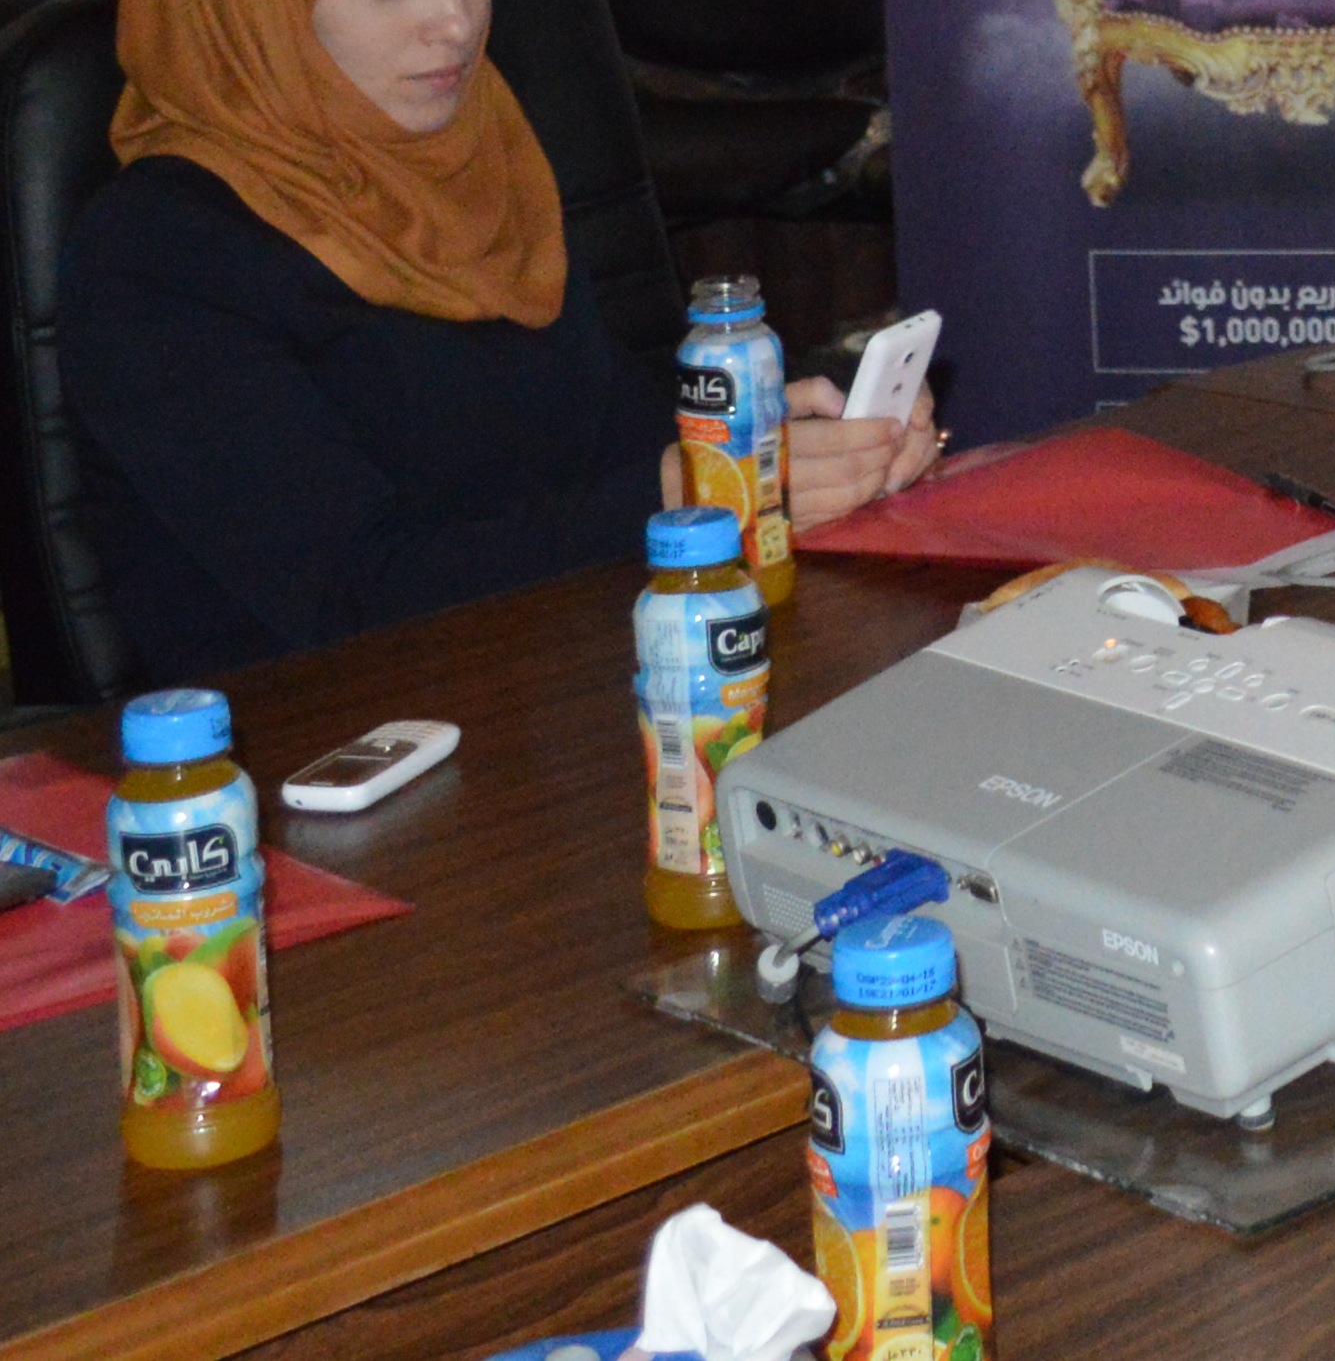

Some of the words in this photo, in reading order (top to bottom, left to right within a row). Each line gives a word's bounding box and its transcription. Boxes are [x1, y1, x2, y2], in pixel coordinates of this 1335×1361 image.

[1159, 279, 1227, 311] فوائد
[1230, 279, 1291, 311] بدون
[978, 774, 1062, 808] EPSON
[128, 836, 230, 883] كابي
[1102, 929, 1159, 966] EPSON
